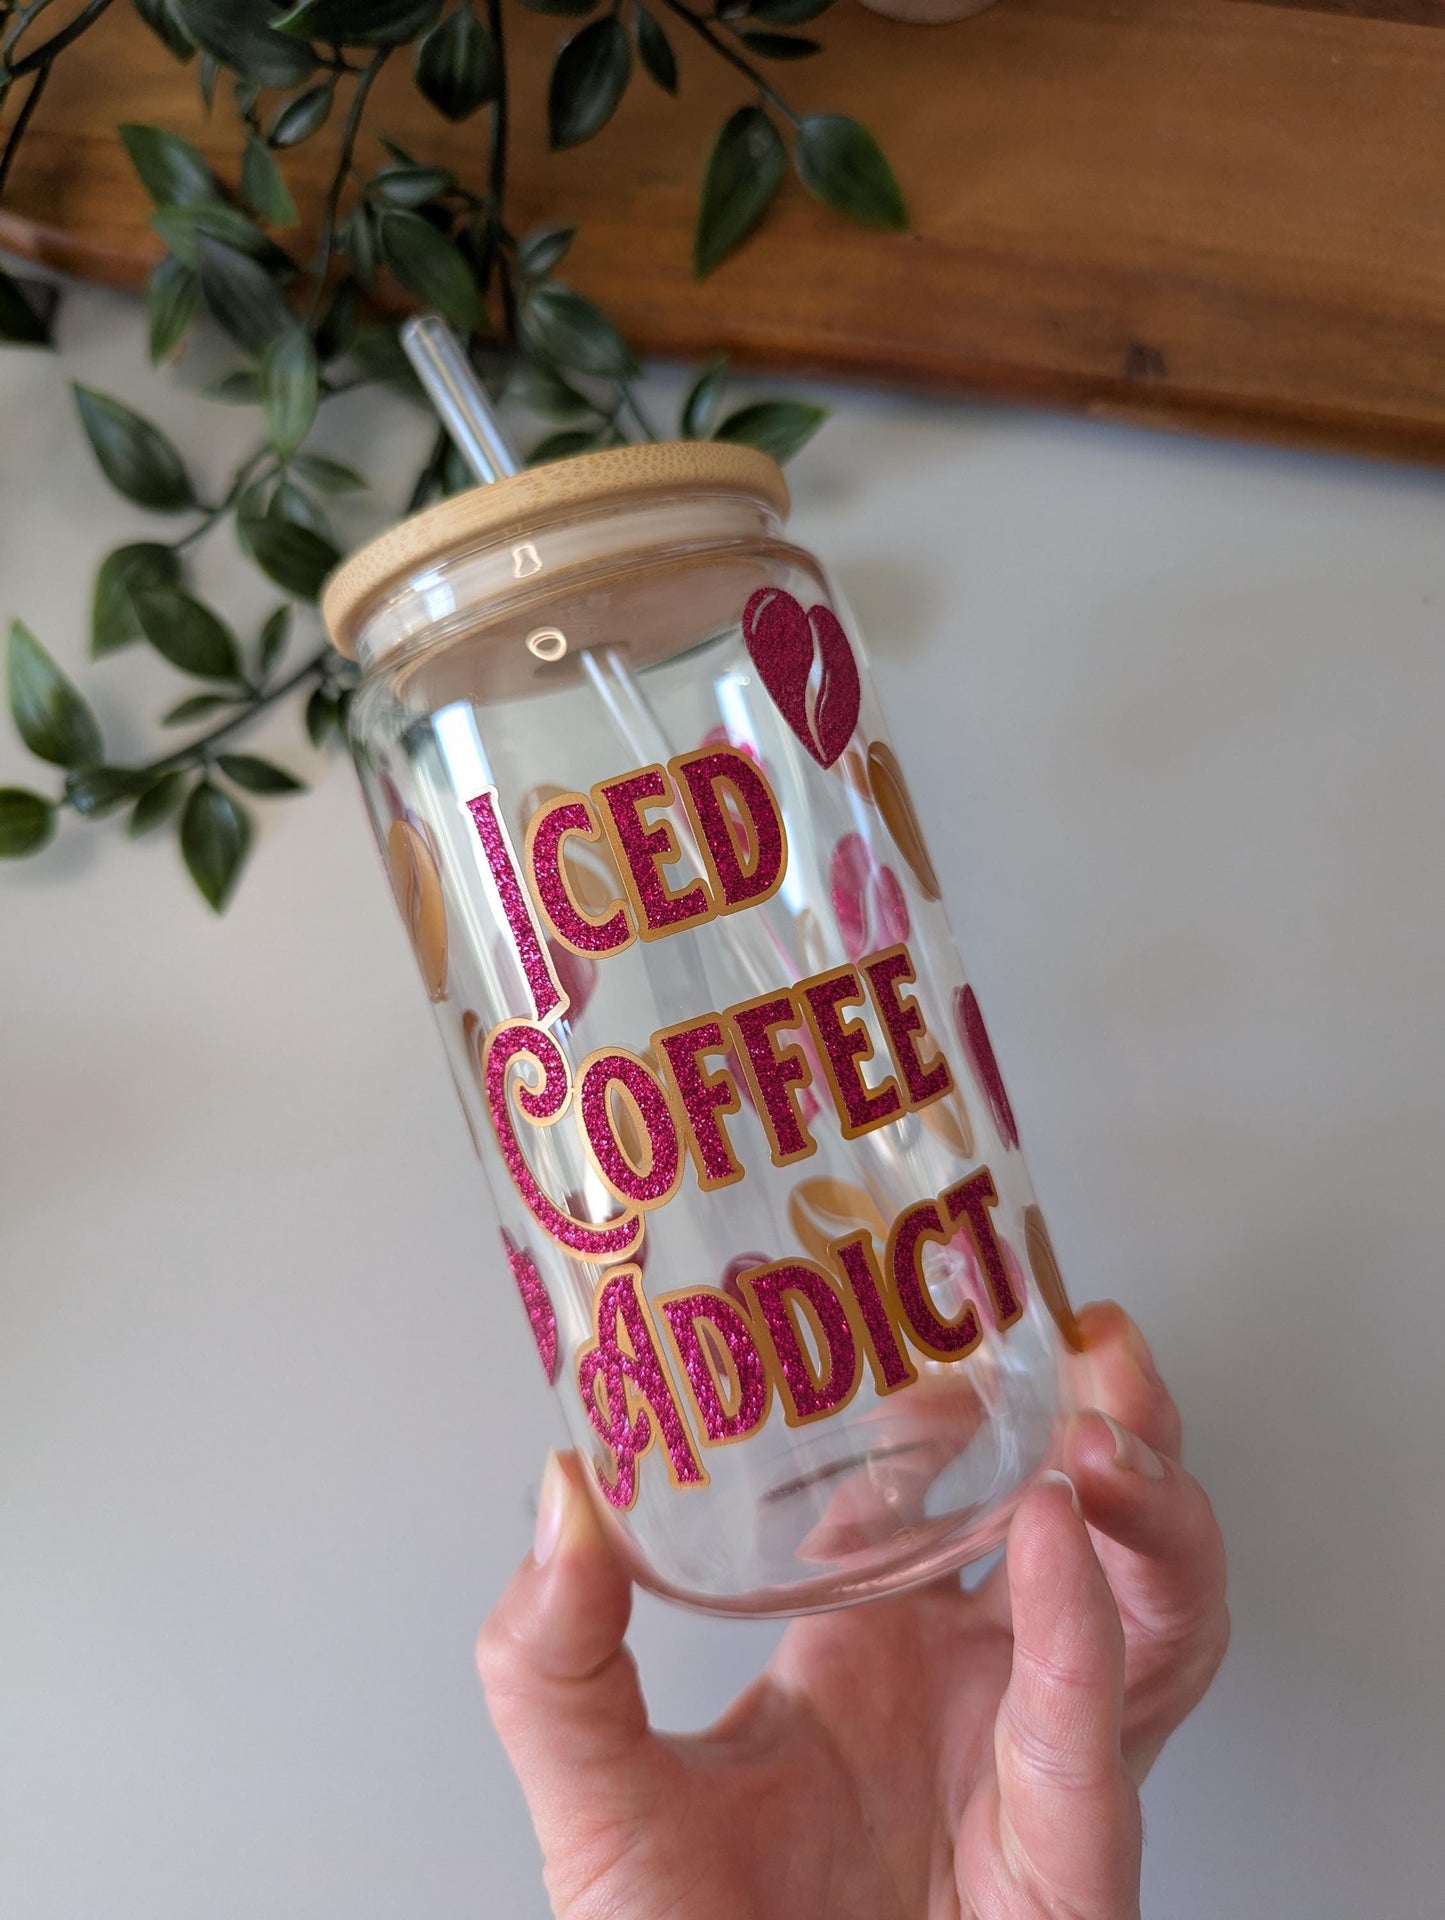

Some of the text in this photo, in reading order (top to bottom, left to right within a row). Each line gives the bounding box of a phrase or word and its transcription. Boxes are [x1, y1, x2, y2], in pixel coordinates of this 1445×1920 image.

[463, 745, 787, 1022] ICED
[483, 944, 954, 1263] COFFEE
[575, 1165, 1022, 1511] ADDICT
